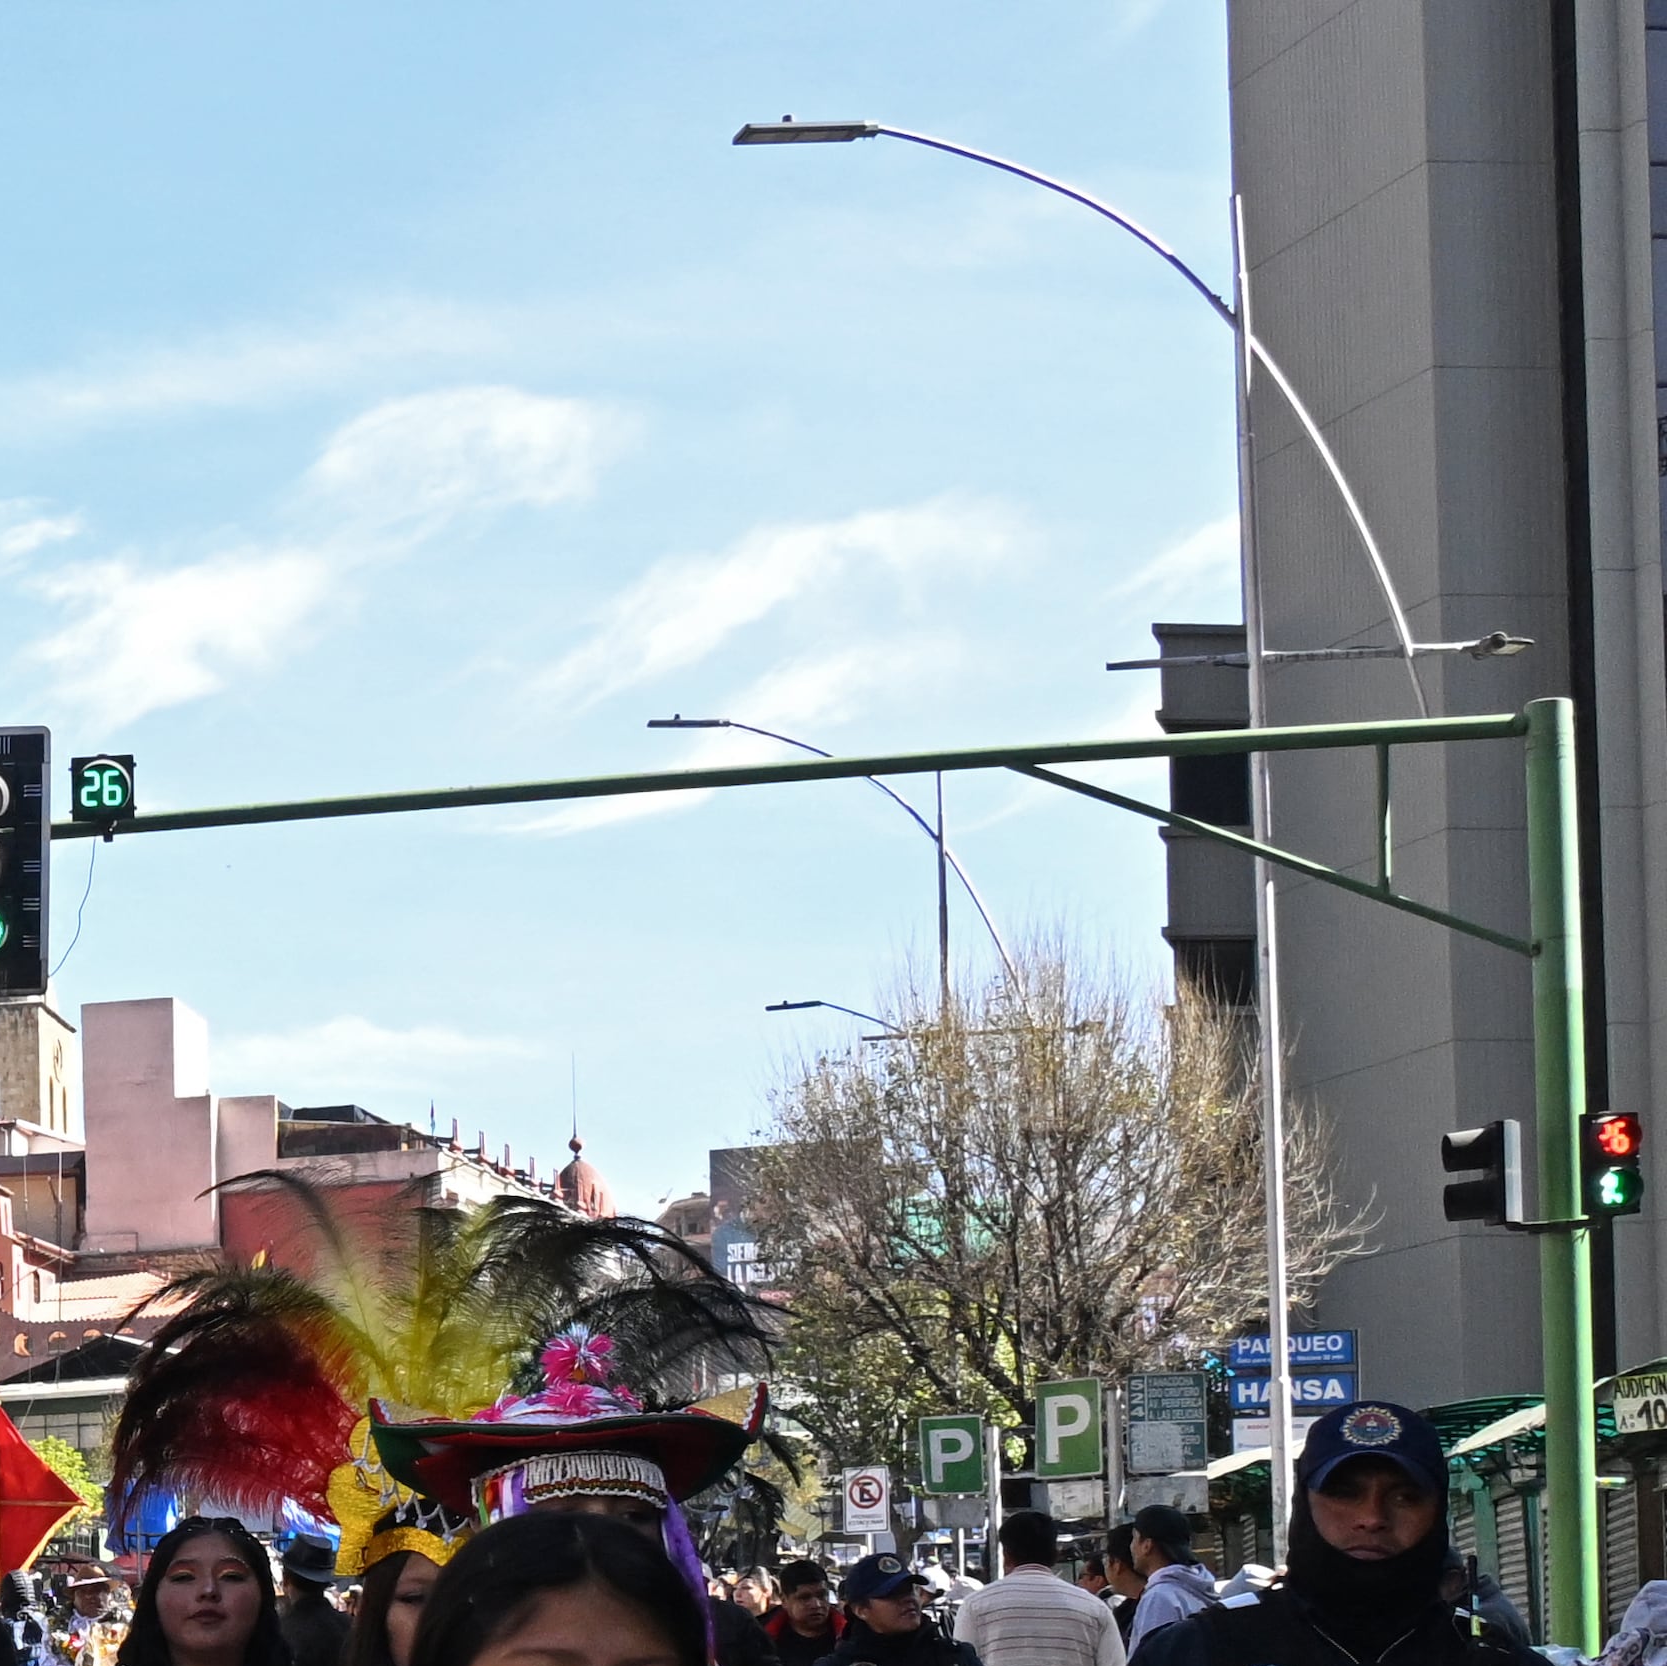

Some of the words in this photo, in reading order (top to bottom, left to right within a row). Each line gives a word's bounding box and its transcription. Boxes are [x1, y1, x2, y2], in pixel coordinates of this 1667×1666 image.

[81, 770, 122, 807] 26
[929, 1428, 974, 1483] P
[1045, 1393, 1091, 1464] P
